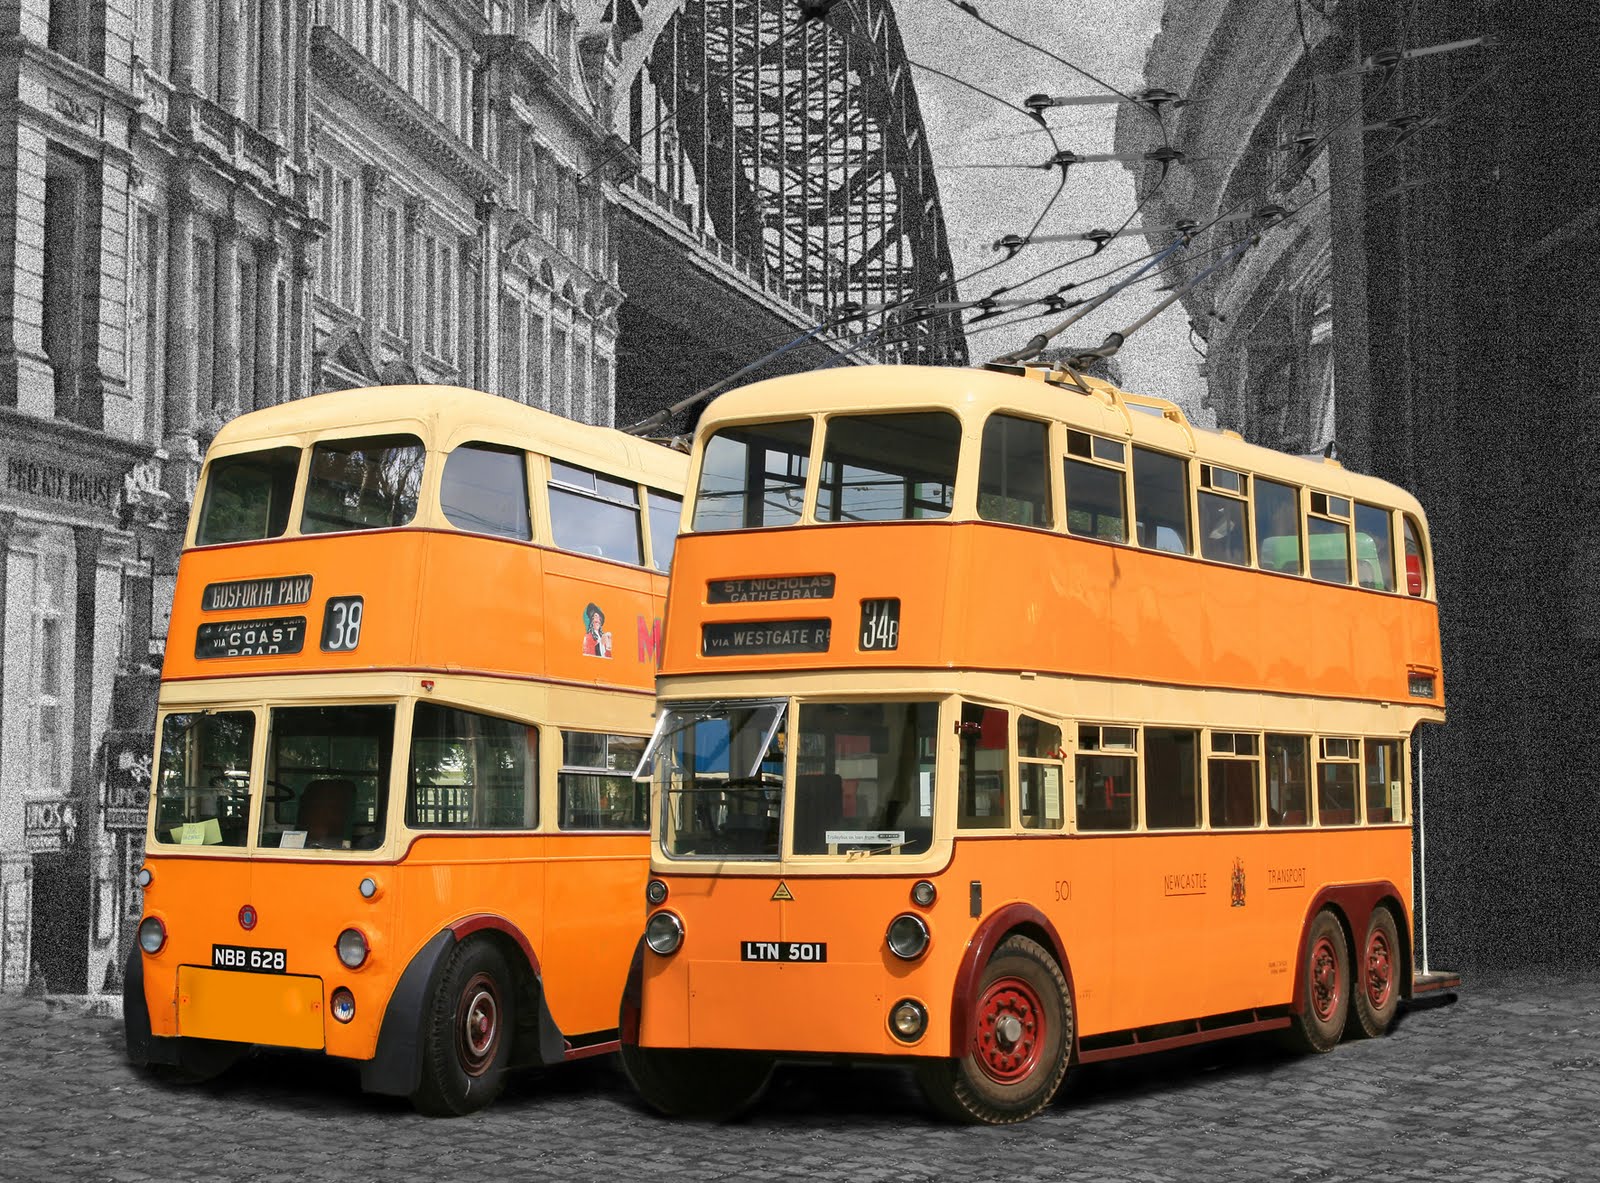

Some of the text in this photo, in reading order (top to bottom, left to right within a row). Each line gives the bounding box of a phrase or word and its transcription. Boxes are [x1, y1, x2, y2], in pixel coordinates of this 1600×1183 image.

[212, 577, 310, 608] GOSFORTH PARK
[750, 576, 831, 591] NICHOLAS
[731, 588, 822, 603] CATHEDRAL
[328, 601, 363, 649] 38
[213, 627, 297, 648] VIA COAST
[711, 639, 730, 647] VIA
[733, 629, 809, 646] WESTGATE
[1055, 880, 1072, 902] 501
[1164, 868, 1306, 894] NEWCASTLE TRANSPORT
[215, 948, 285, 970] NBB 628
[746, 942, 820, 961] LTN 501
